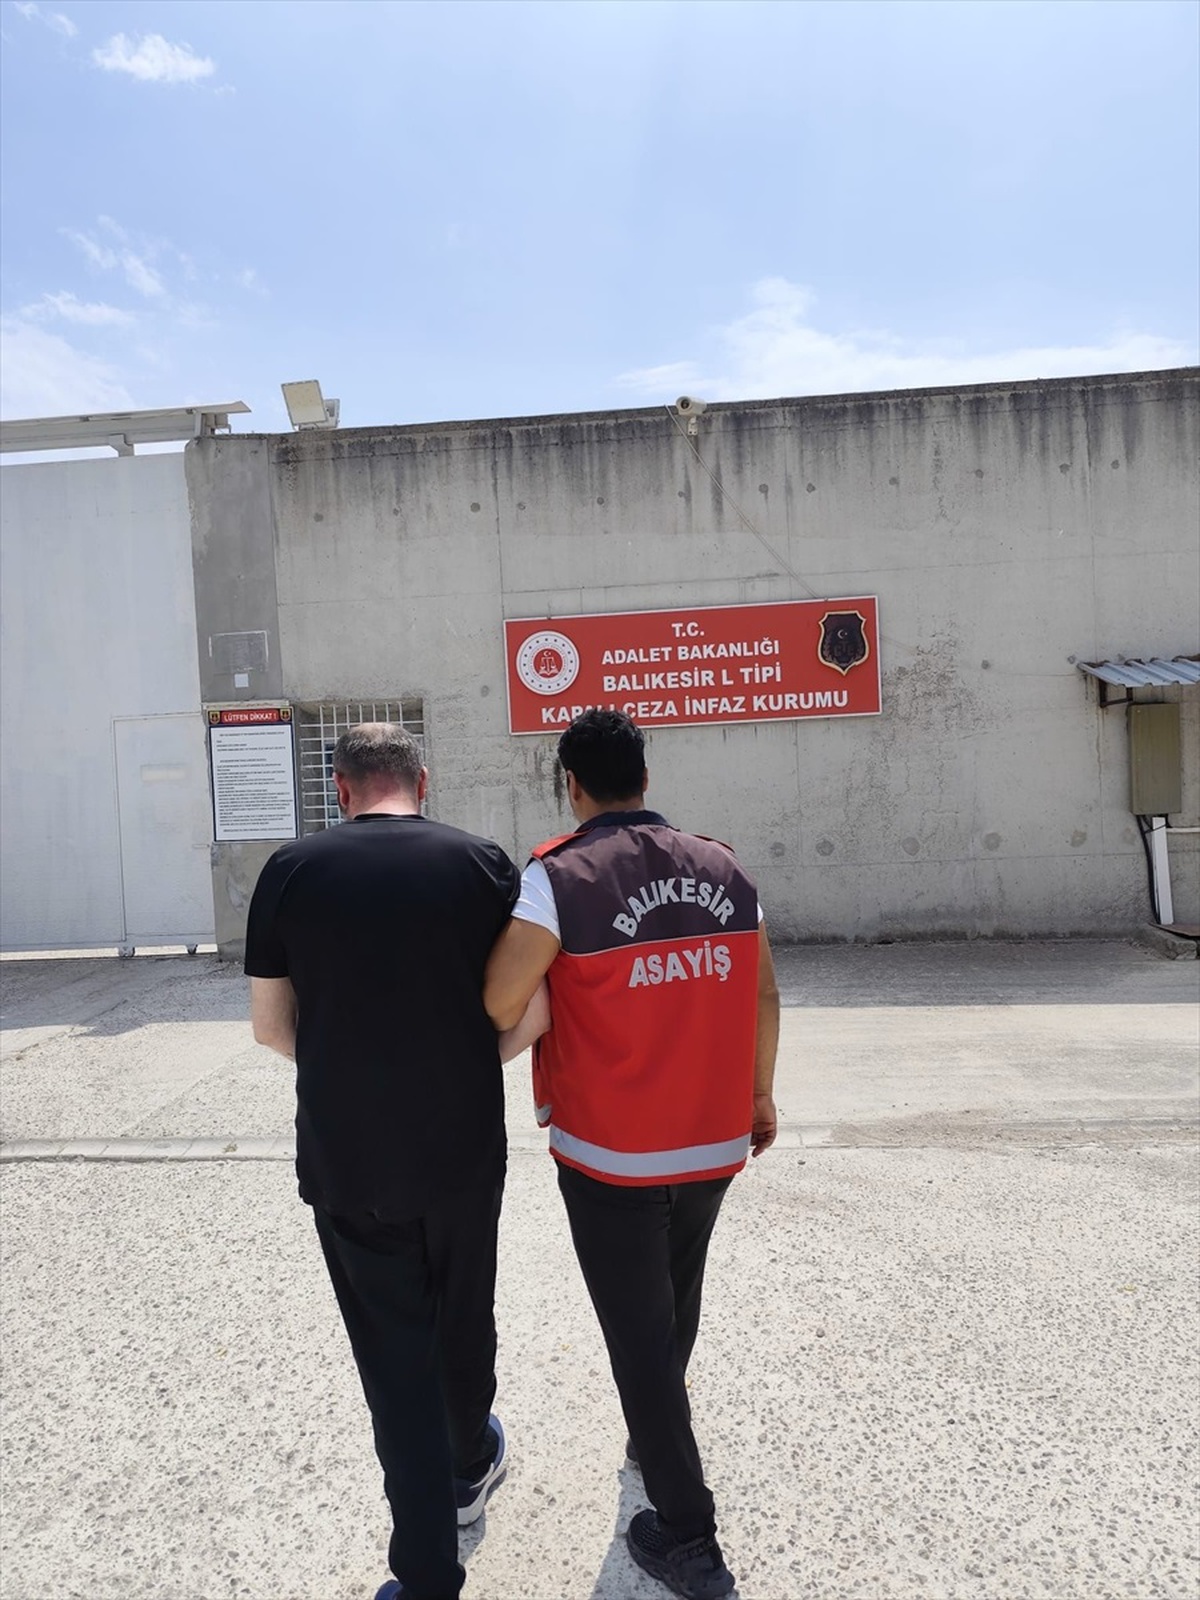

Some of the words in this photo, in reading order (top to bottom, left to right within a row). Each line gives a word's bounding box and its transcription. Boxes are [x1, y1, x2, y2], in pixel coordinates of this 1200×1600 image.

[671, 622, 705, 637] T.C.
[602, 647, 672, 665] ADALET
[677, 637, 780, 660] BAKANLIĞI
[603, 667, 715, 692] BALIKESİR
[721, 669, 734, 685] L
[740, 662, 782, 684] TİPİ
[623, 700, 678, 719] CEZA
[684, 695, 747, 716] İNFAZ
[752, 690, 849, 711] KURUMU
[612, 877, 735, 938] BALIKESİR
[628, 940, 732, 988] ASAYİŞ
